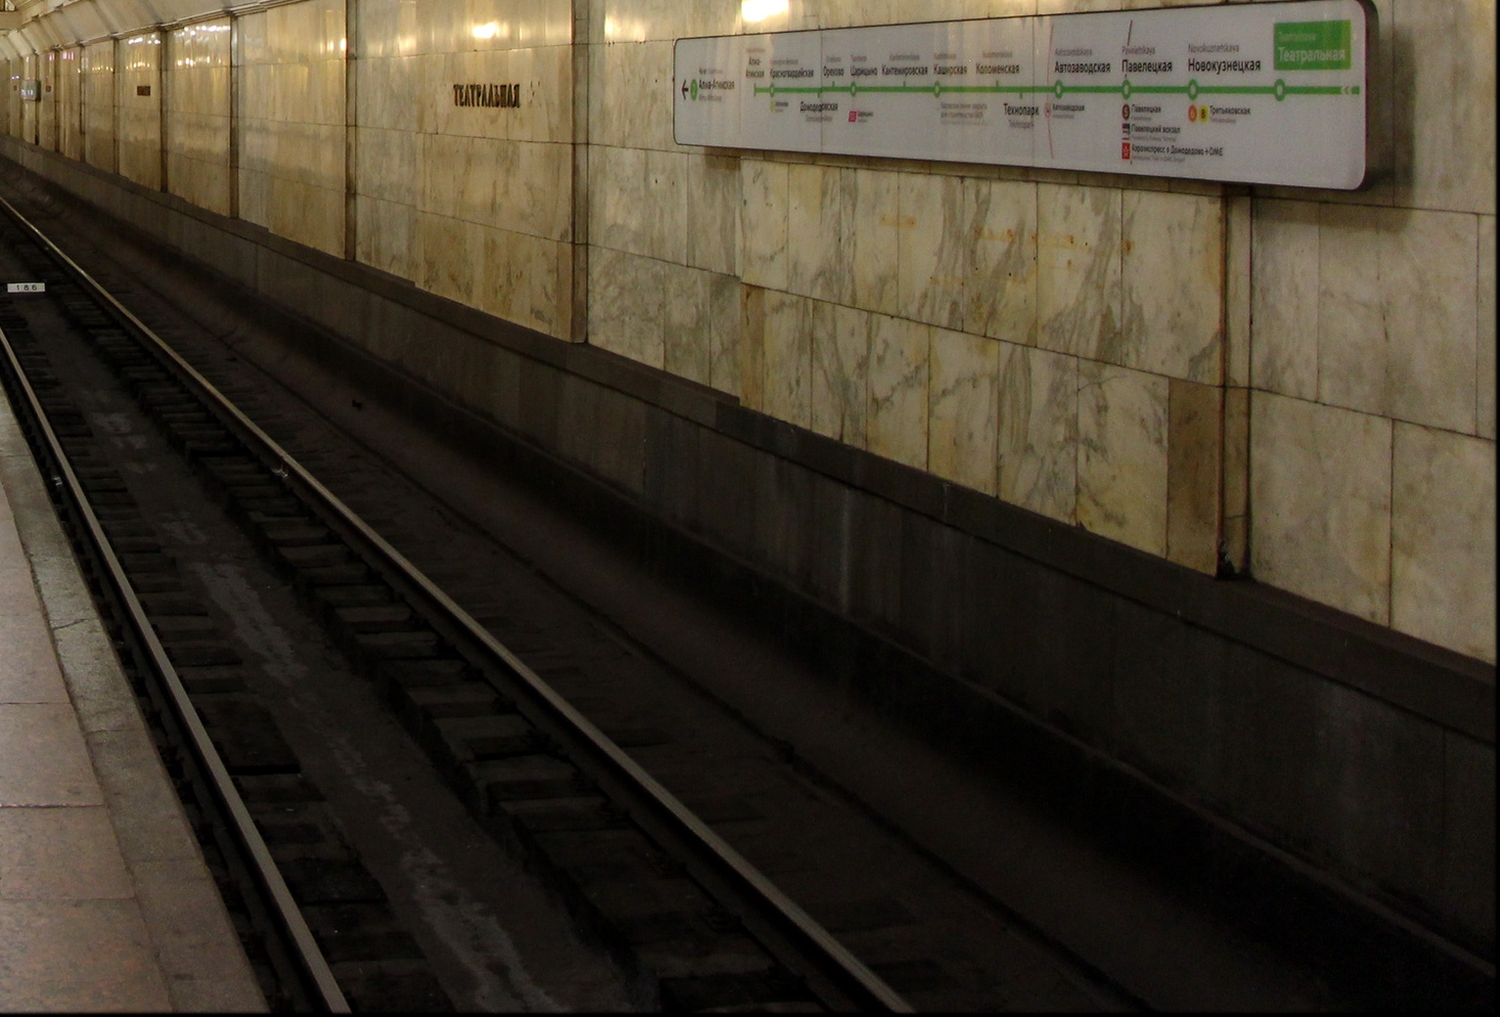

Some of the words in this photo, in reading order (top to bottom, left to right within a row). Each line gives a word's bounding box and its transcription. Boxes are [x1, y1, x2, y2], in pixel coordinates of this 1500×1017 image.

[1277, 46, 1347, 65] Театральная
[976, 63, 1020, 75] Коломенская
[1054, 61, 1111, 75] Автозаводская
[1122, 59, 1173, 74] Павелецкая
[1188, 59, 1261, 75] Новокузнецкая
